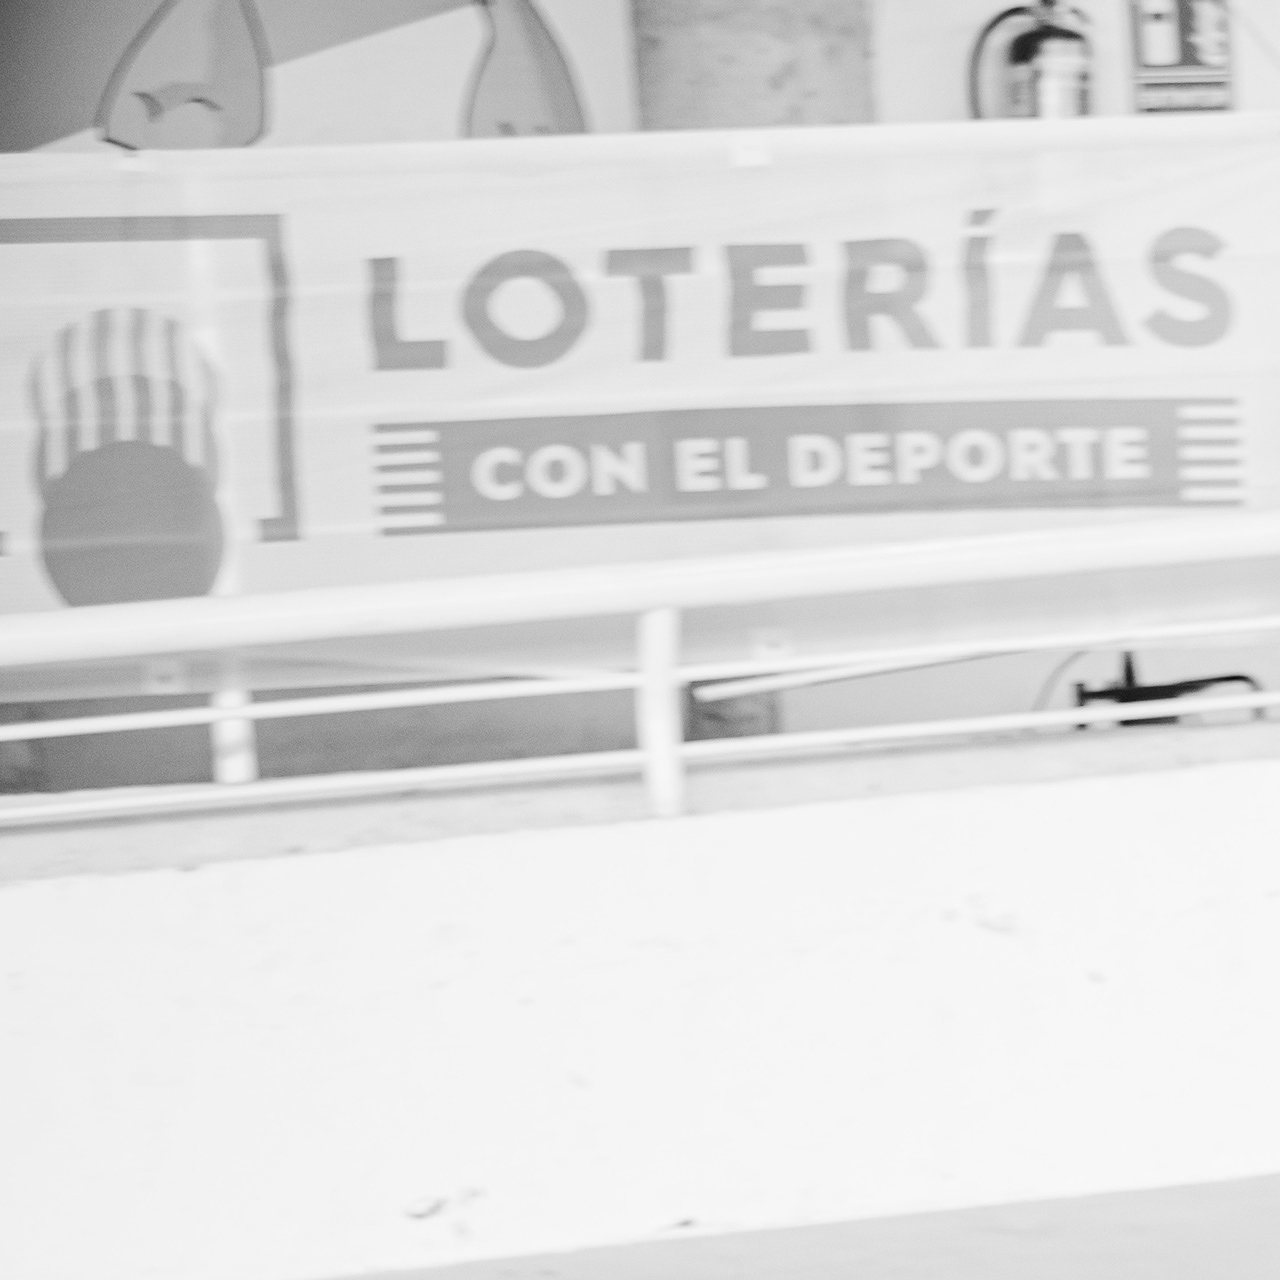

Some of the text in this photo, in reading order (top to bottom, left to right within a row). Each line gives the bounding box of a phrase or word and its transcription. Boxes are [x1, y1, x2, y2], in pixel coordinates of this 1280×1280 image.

[366, 207, 1236, 371] LOTERÍAS
[471, 425, 1152, 504] CON EL DEPORTE
